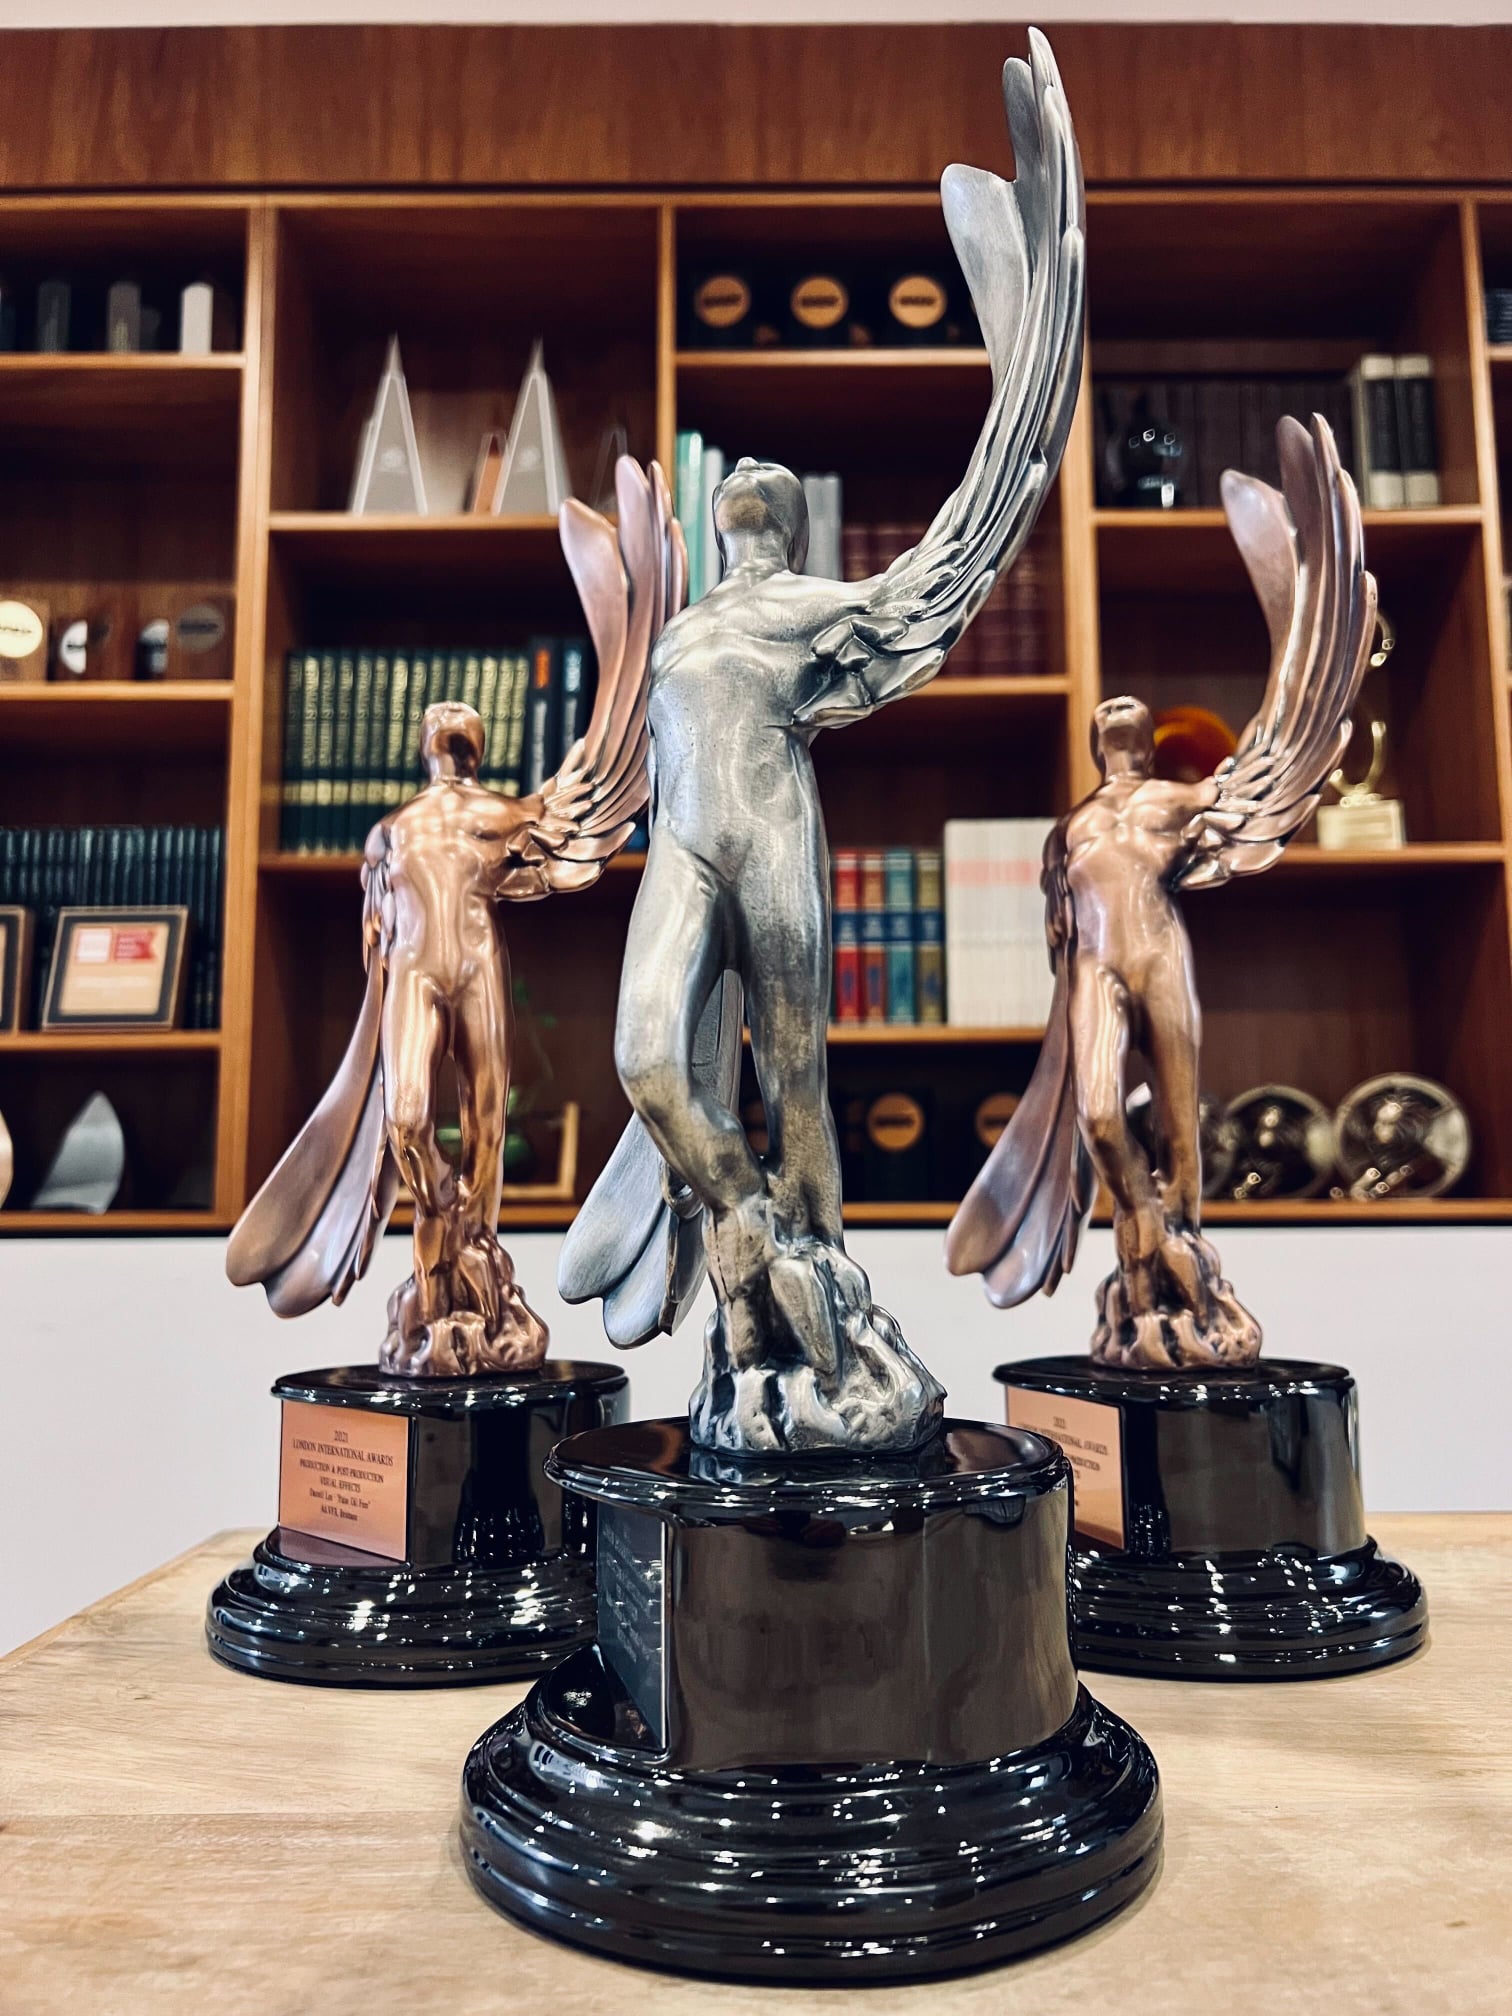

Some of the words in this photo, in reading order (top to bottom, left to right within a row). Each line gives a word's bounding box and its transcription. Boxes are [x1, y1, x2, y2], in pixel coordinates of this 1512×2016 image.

[293, 1438, 317, 1451] LONDON
[317, 1443, 365, 1461] INTERNATIONAL
[367, 1452, 394, 1466] AWARDS
